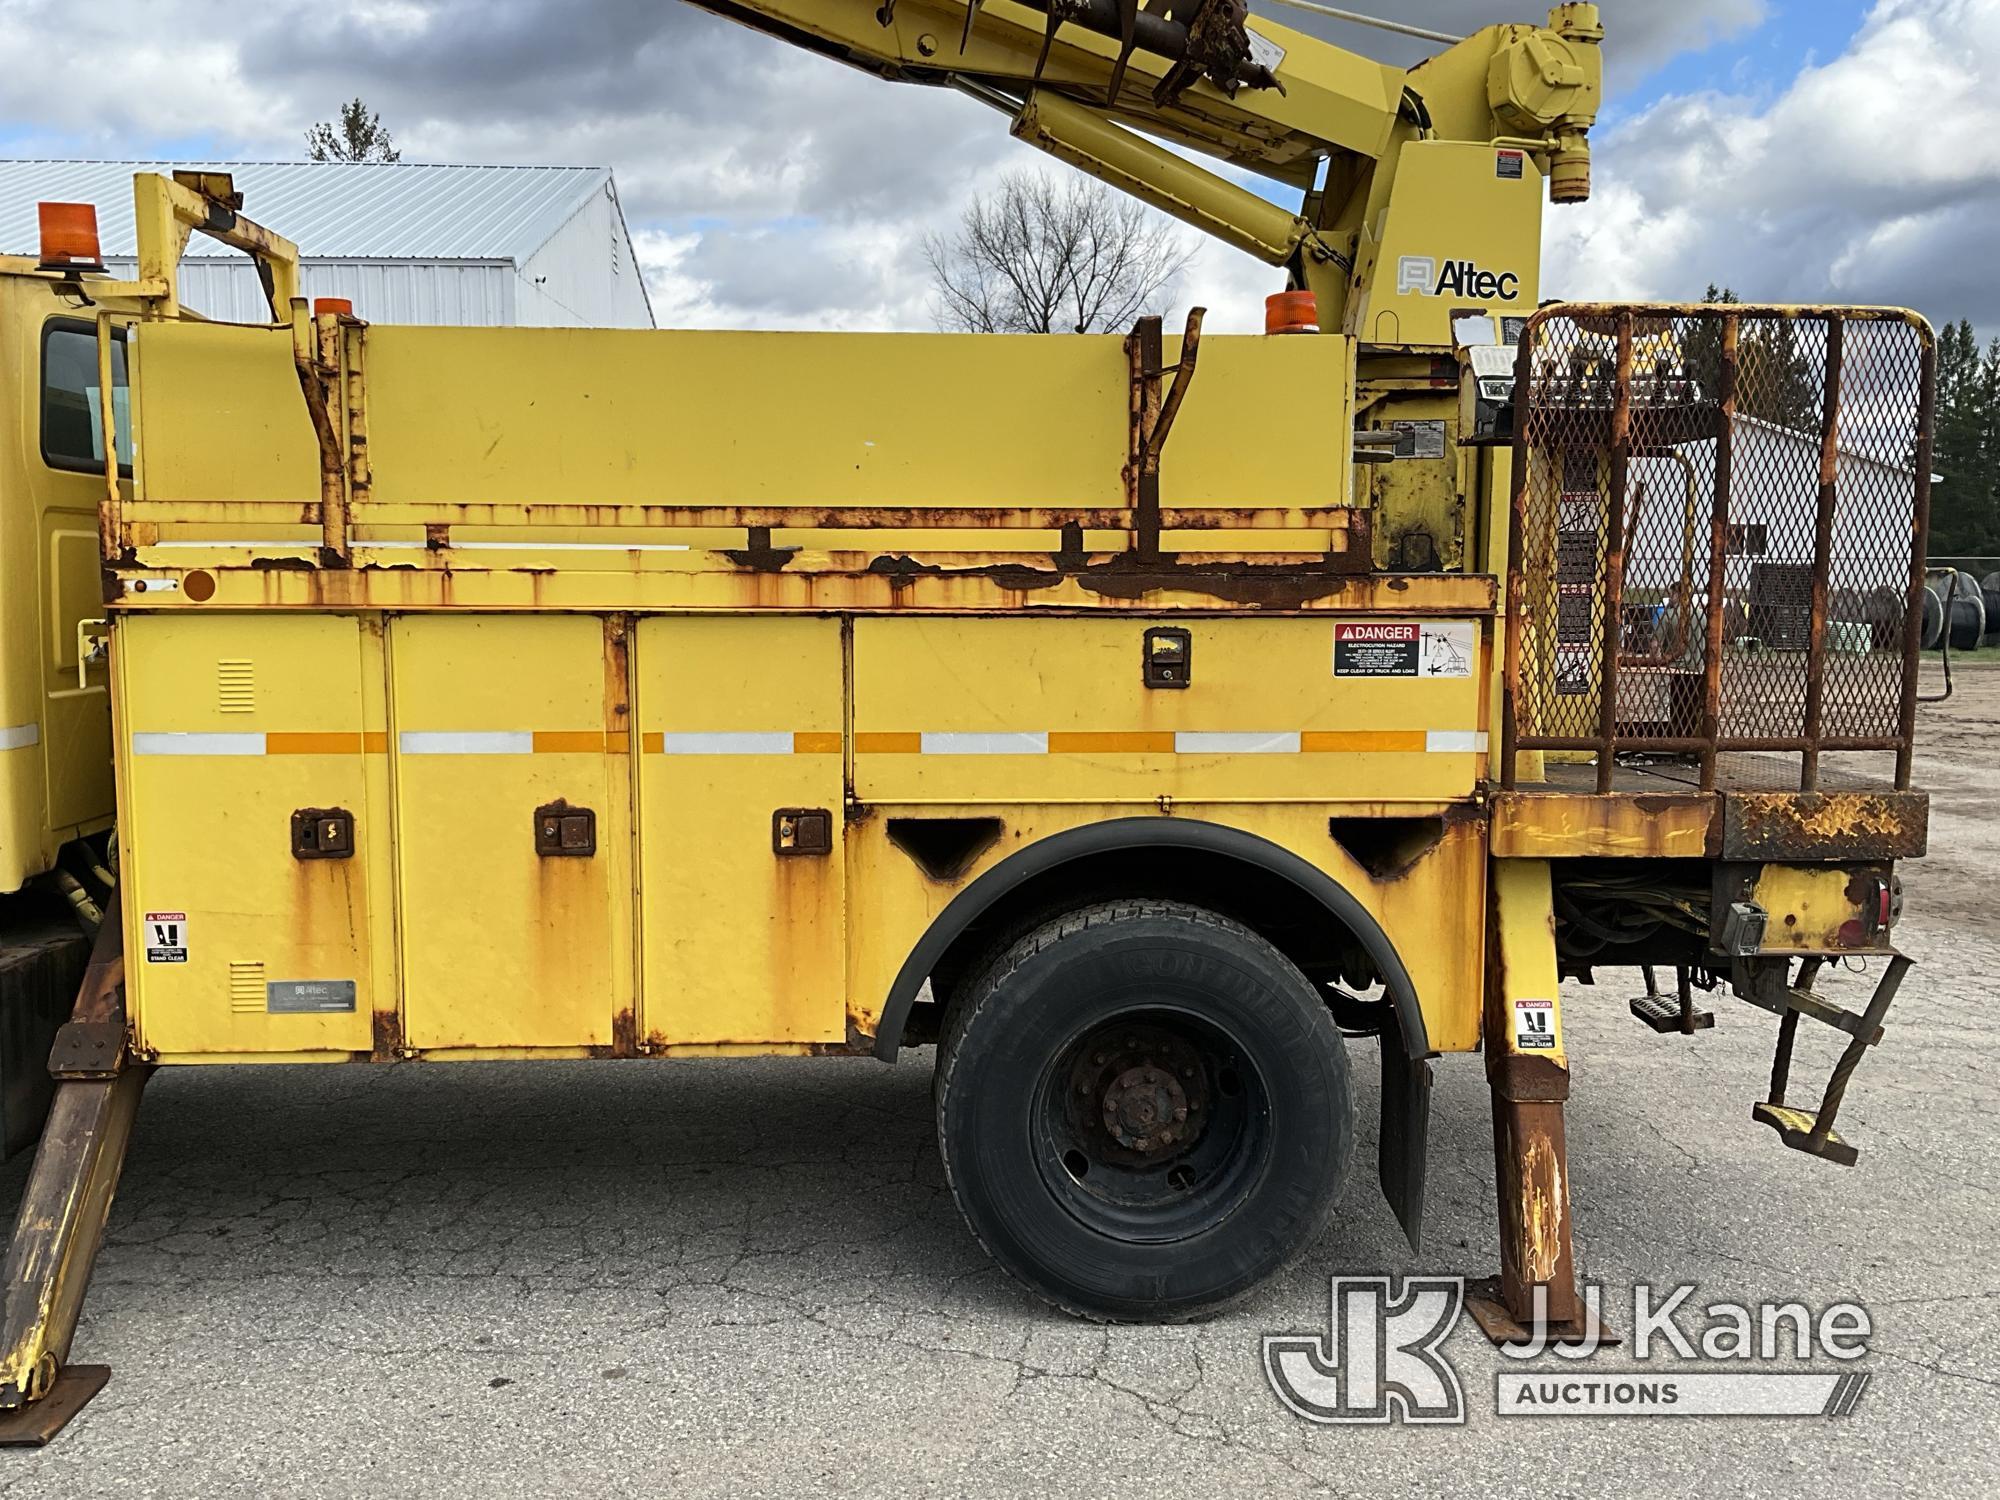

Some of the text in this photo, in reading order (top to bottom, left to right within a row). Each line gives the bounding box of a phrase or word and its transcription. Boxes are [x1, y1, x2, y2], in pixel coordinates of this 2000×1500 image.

[1434, 260, 1518, 300] Altec
[1355, 627, 1413, 639] DANGER
[306, 985, 328, 994] Altec
